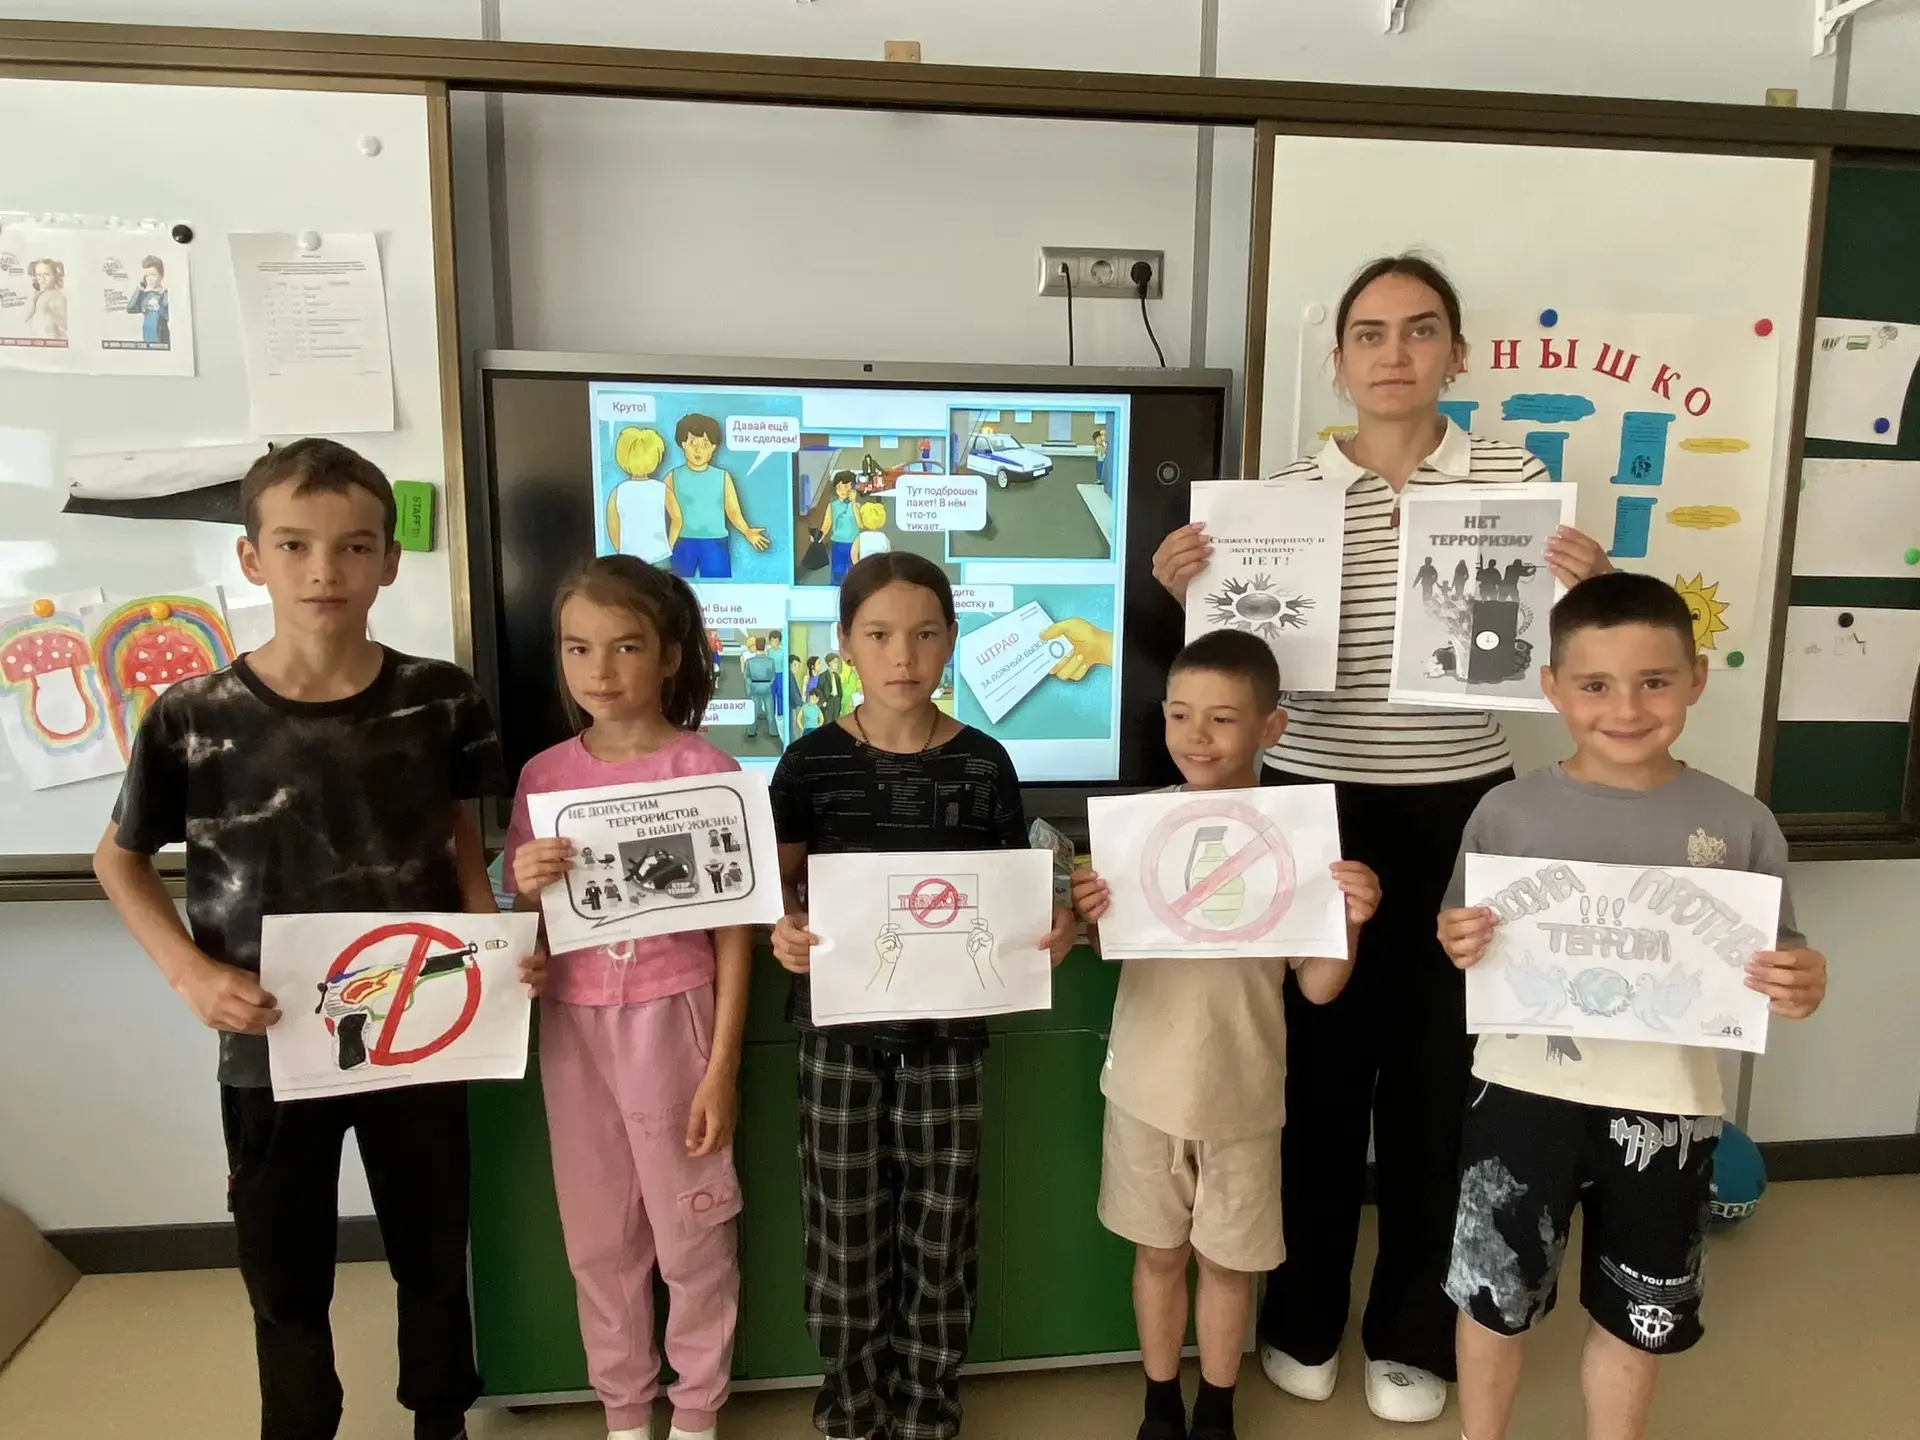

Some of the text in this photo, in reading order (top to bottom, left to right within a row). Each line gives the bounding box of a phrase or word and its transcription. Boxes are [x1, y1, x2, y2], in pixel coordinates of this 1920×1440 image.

[1457, 338, 1711, 417] НЫШКО
[613, 402, 646, 413] Круто!
[733, 421, 788, 432] Давай ещё
[733, 435, 797, 445] так сделаем!
[907, 486, 978, 497] Тут подброшен
[907, 499, 966, 507] пакет! В нём
[1464, 515, 1500, 528] НЕТ
[1429, 534, 1533, 547] ТЕРРОРИЗМУ
[713, 604, 728, 612] Вы
[976, 633, 1020, 665] ШТРАФ
[981, 679, 992, 689] ЗА
[993, 655, 1024, 682] ЛОЖНЫЙ
[568, 799, 659, 819] НЕ ДОПУСТИМ
[606, 807, 699, 828] ТЕРРОРИСТОВ
[637, 815, 738, 838] В НАШУ ЖИЗНЬ!
[1628, 868, 1769, 967] ПРОТИВ
[1721, 1025, 1743, 1037] 46
[1620, 1263, 1638, 1278] ARE
[1641, 1274, 1663, 1285] YOU
